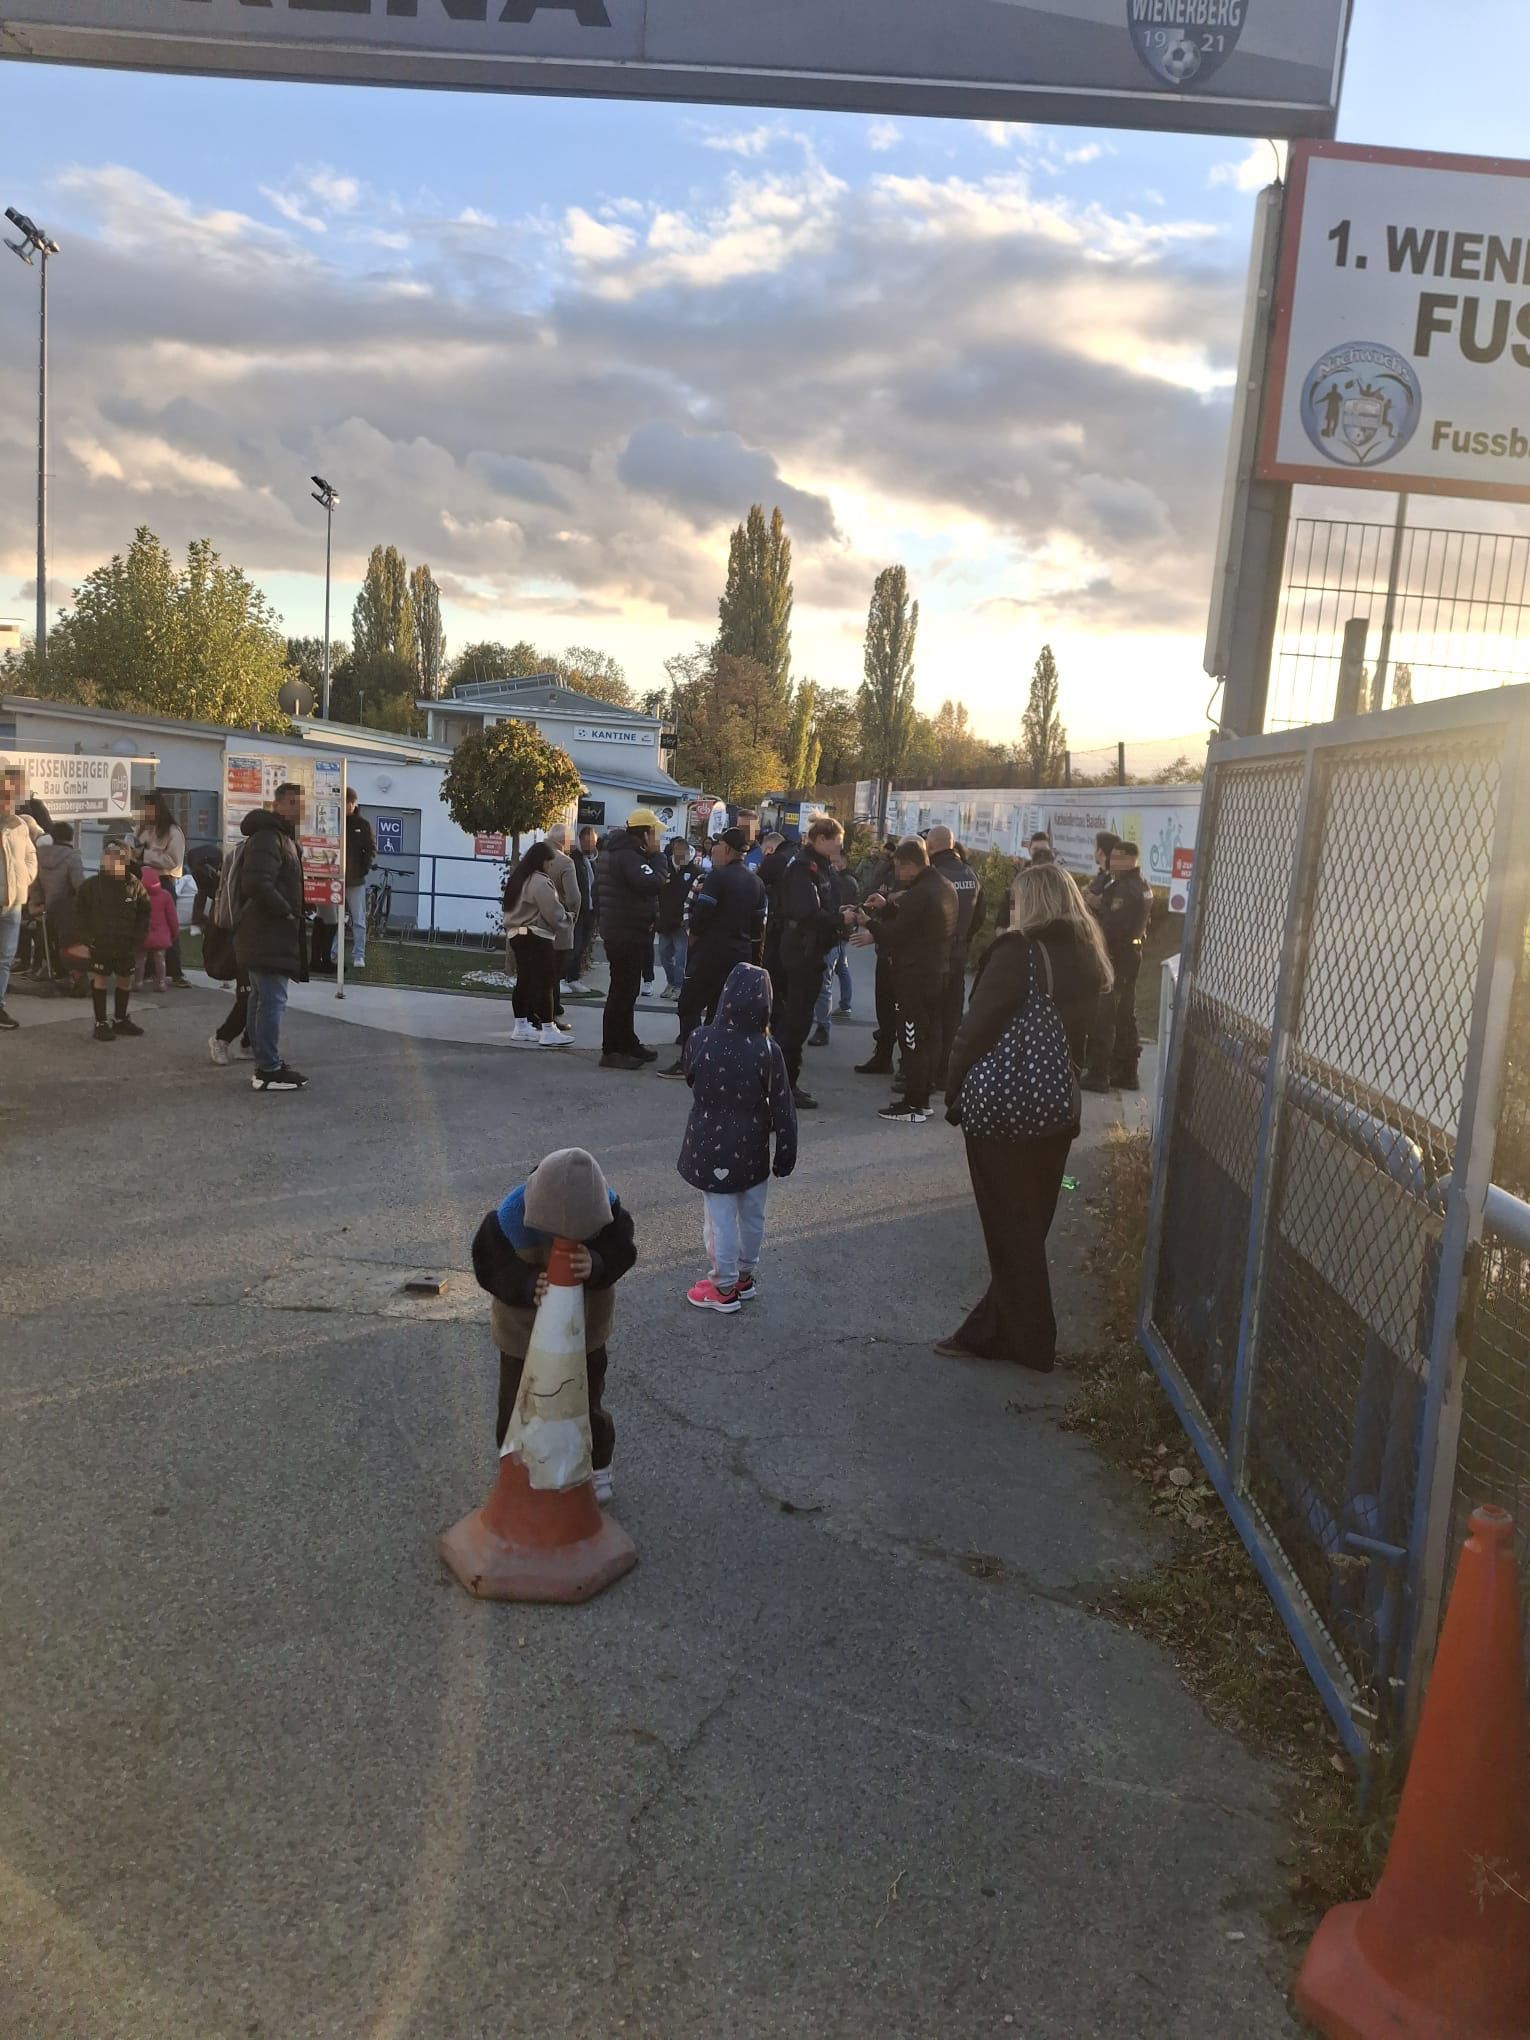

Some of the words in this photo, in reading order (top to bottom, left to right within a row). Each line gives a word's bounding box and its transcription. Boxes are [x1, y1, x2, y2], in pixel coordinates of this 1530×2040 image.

[1132, 0, 1241, 26] WIENERBERG
[1143, 30, 1167, 48] 19
[1201, 34, 1225, 52] 21
[1328, 219, 1368, 270] 1.
[1386, 225, 1530, 286] WIEN
[1431, 420, 1530, 459] Fussb
[592, 730, 637, 742] KANTINE
[43, 781, 61, 795] Bau
[63, 781, 89, 795] GmbH
[46, 800, 104, 812] eissenberger-bau.at
[380, 822, 400, 832] WC
[951, 880, 976, 890] OLIZEI
